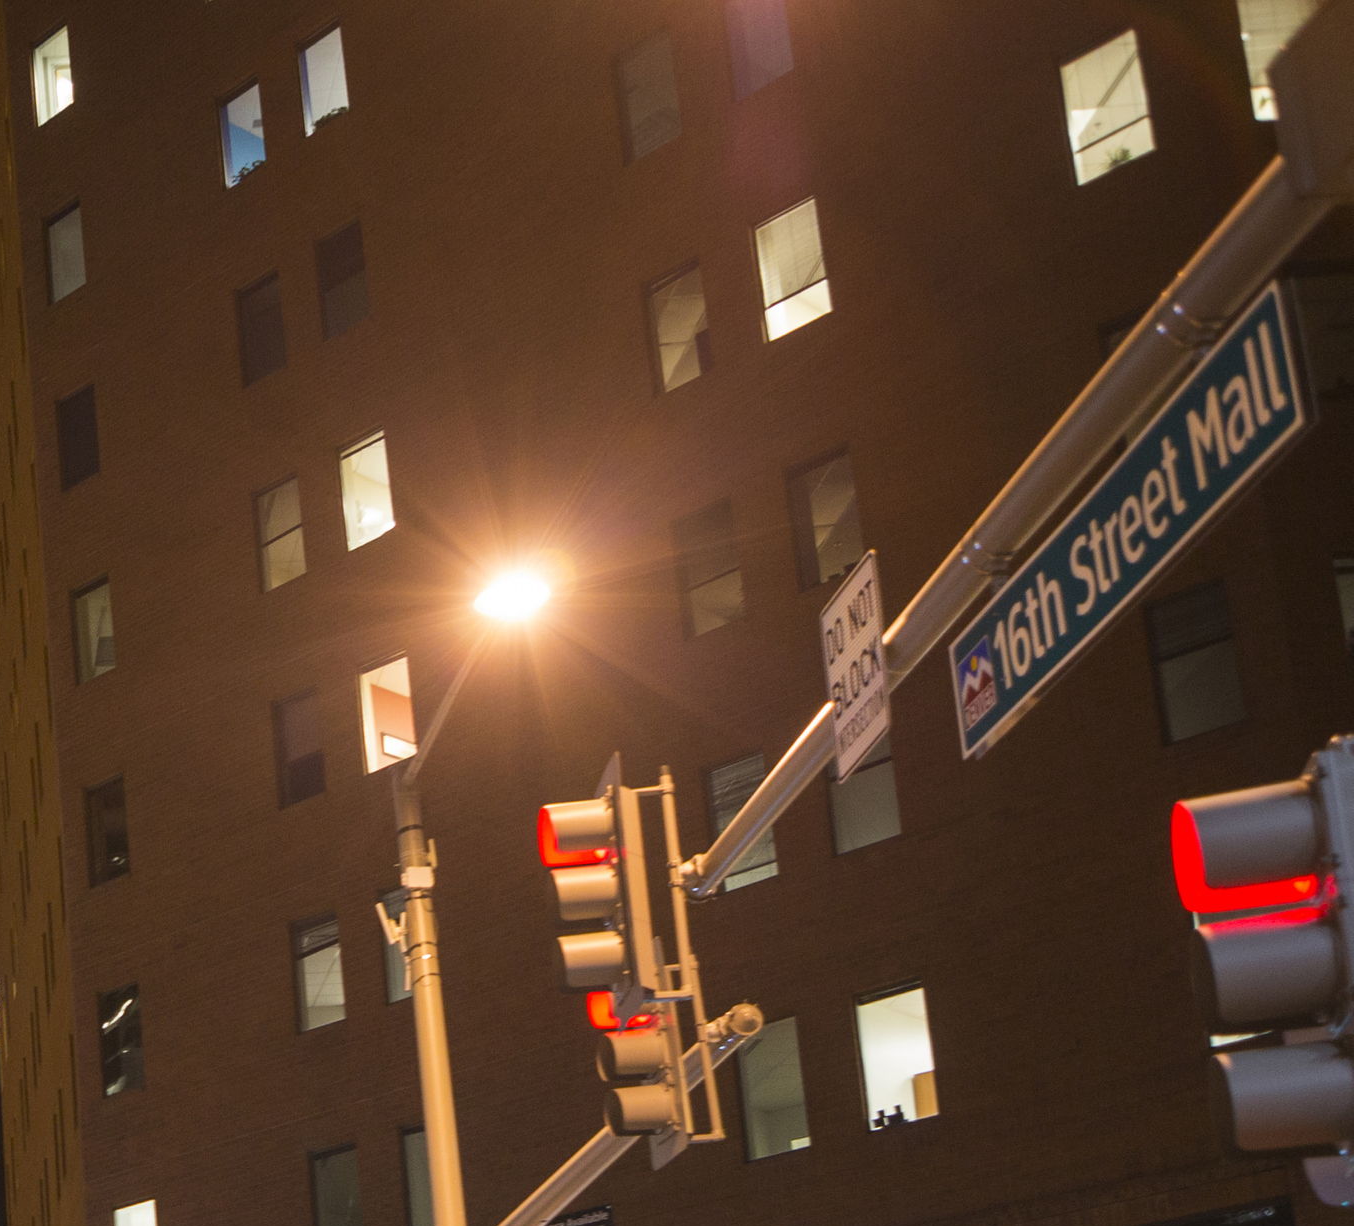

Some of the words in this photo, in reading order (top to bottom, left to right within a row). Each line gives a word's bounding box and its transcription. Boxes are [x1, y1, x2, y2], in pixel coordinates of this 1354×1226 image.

[993, 571, 1067, 690] 16th
[1070, 436, 1187, 617] Street
[1186, 321, 1287, 491] Mall
[825, 617, 844, 666] DO
[848, 579, 874, 640] NOT
[833, 635, 881, 719] BLOCK
